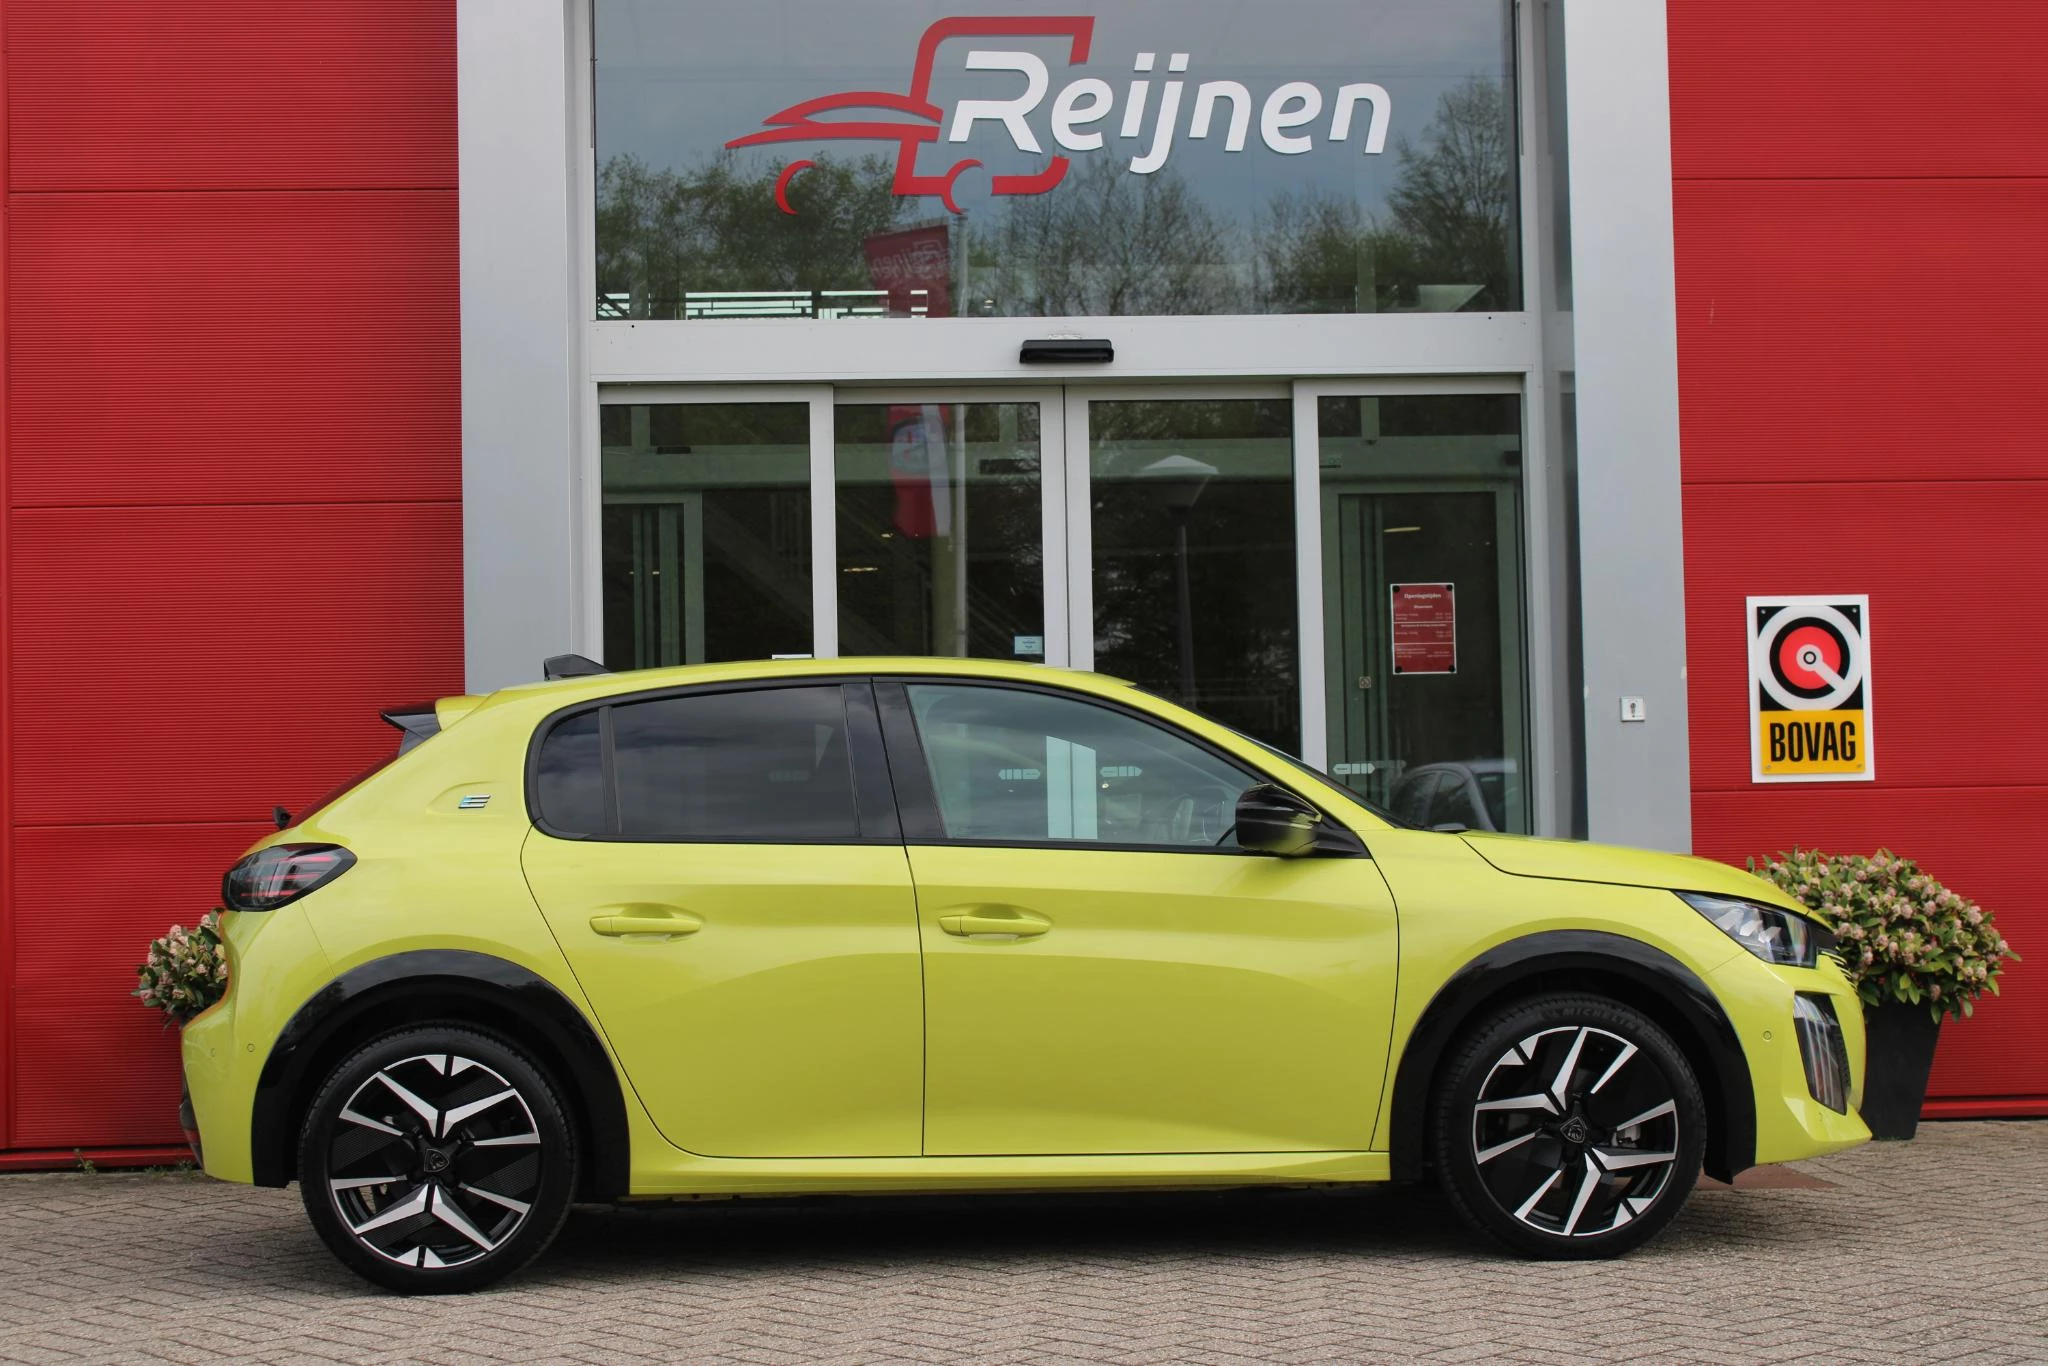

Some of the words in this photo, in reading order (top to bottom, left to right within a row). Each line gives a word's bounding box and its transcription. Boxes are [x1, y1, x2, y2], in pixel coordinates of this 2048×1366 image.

[949, 51, 1392, 174] Reijnen
[1770, 721, 1856, 762] BOVAG
[1563, 1007, 1636, 1030] MICHELIN
